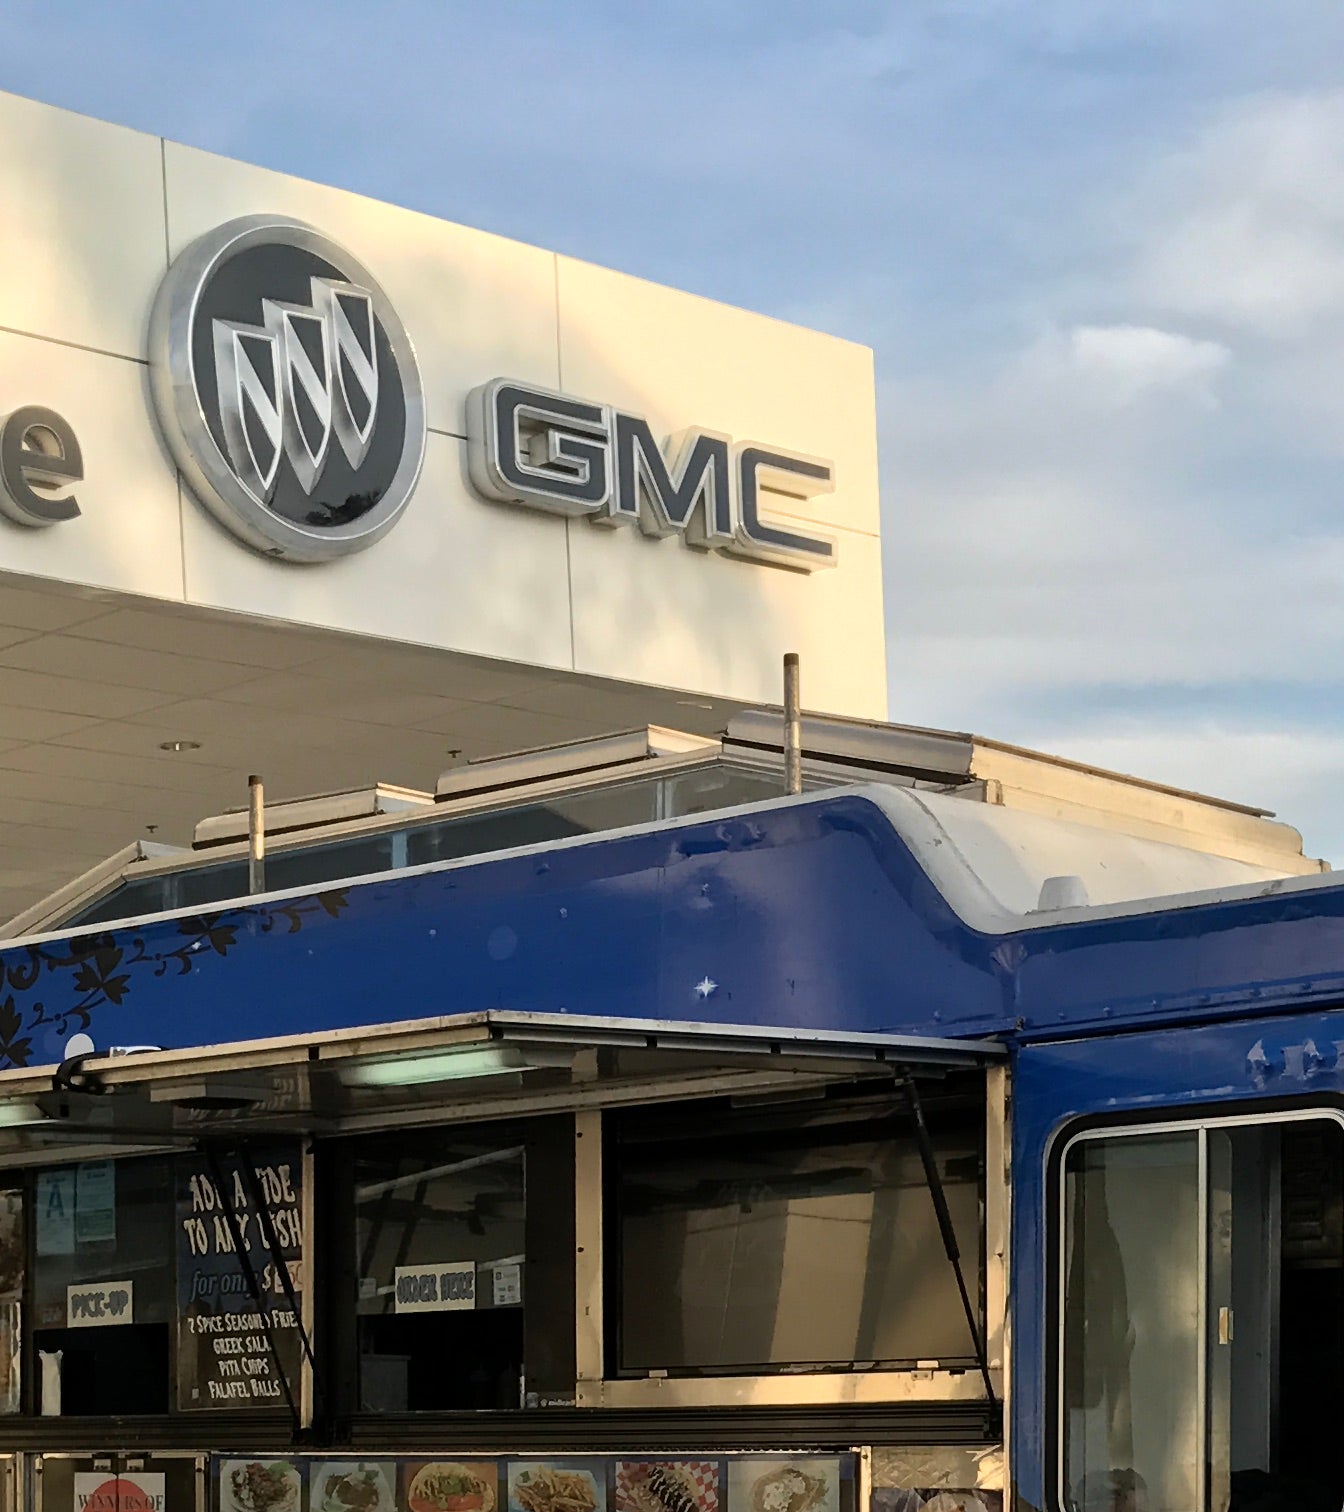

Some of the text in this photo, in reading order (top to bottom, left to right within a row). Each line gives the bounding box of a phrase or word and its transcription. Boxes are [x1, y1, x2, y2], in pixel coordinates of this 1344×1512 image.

[467, 377, 838, 573] GMC
[46, 1182, 64, 1218] A
[232, 1170, 248, 1208] A
[254, 1164, 296, 1206] IDE
[183, 1217, 208, 1255] TO
[189, 1270, 217, 1302] for
[397, 1274, 438, 1304] ORDER
[440, 1270, 474, 1302] HERE
[71, 1289, 129, 1319] PICK-UP
[196, 1314, 225, 1333] SPICE
[271, 1309, 298, 1328] FRIE
[213, 1335, 272, 1354] GREEK SALA
[218, 1357, 270, 1376] PITA CHIPS
[208, 1378, 281, 1399] FALAFEL BALLS
[144, 1493, 164, 1512] OF
